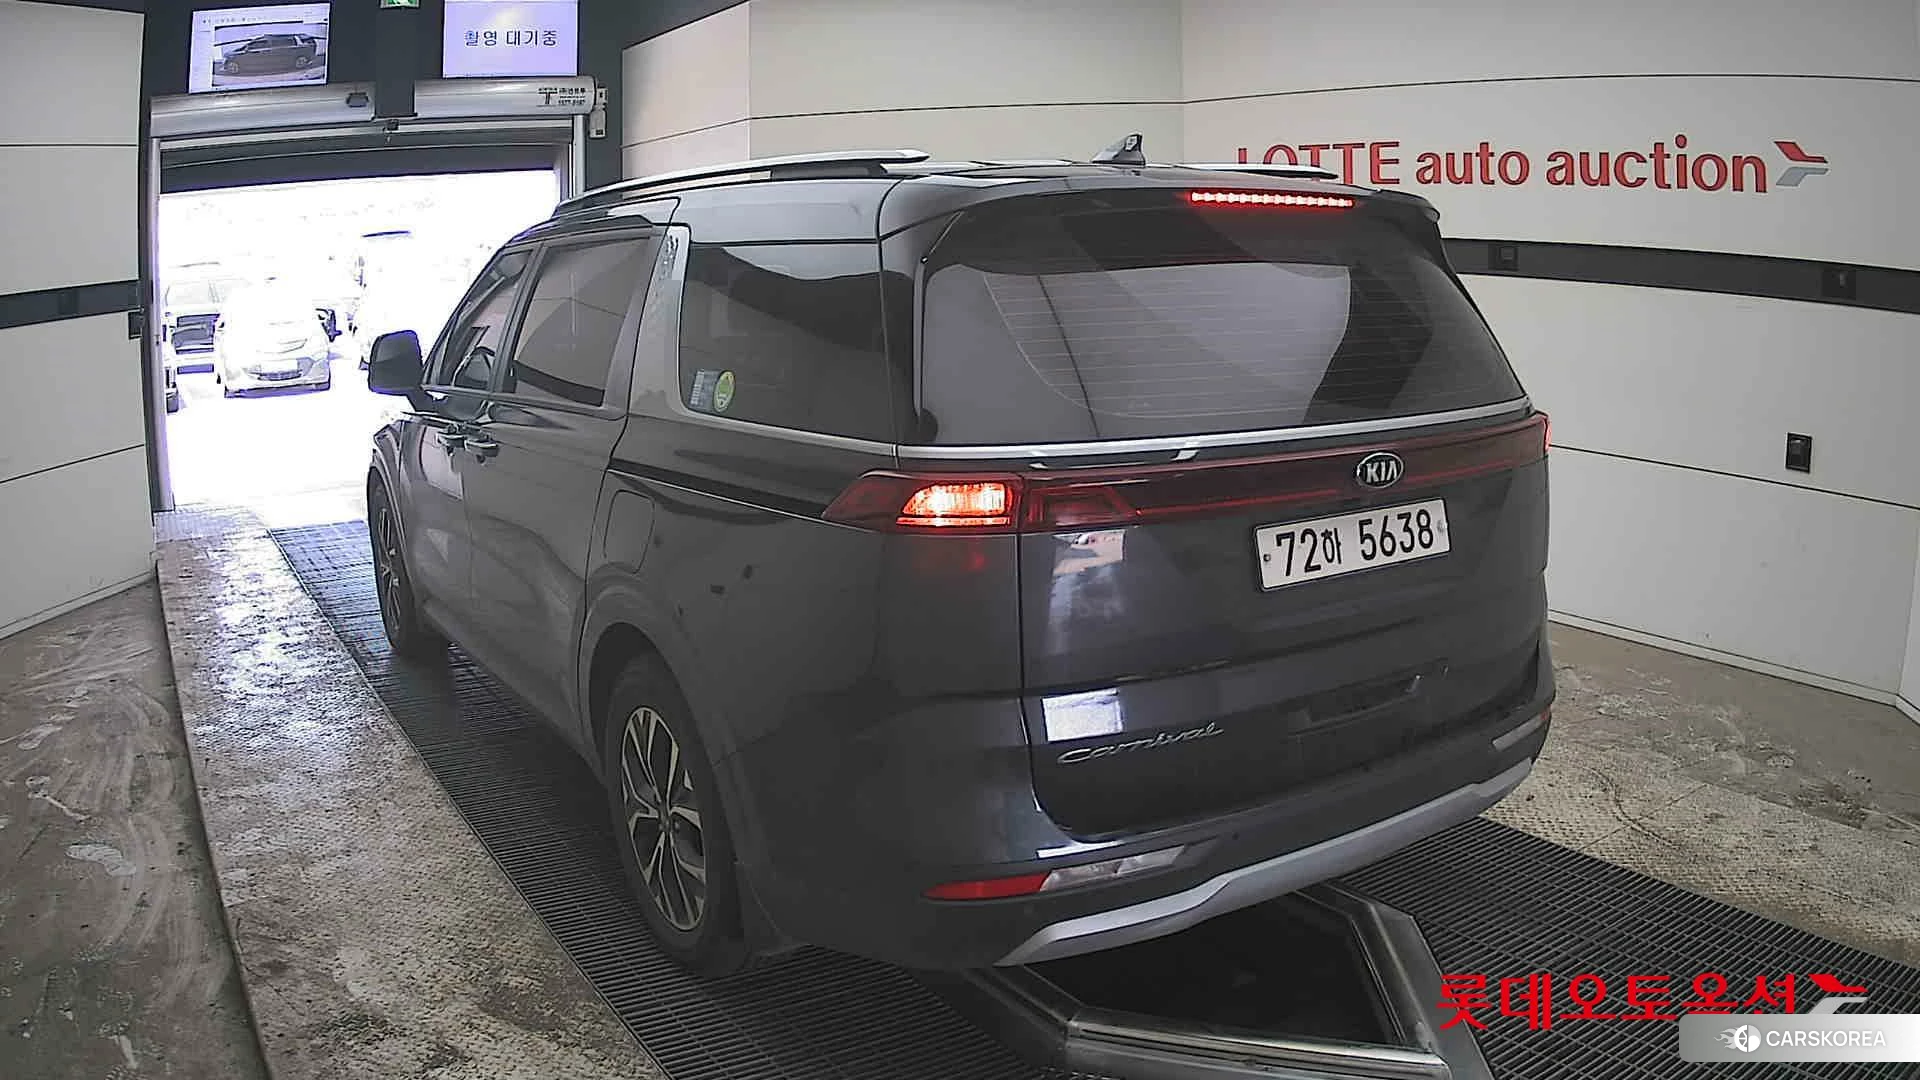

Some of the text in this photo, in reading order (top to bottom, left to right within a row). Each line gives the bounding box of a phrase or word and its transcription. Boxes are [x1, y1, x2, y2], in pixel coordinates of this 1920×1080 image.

[465, 29, 557, 47] 촬영 대기중
[1416, 141, 1530, 186] auto
[1546, 136, 1768, 193] auction
[1366, 461, 1397, 483] KIA
[1276, 508, 1434, 576] 72하 5638
[1058, 722, 1224, 764] Carnival
